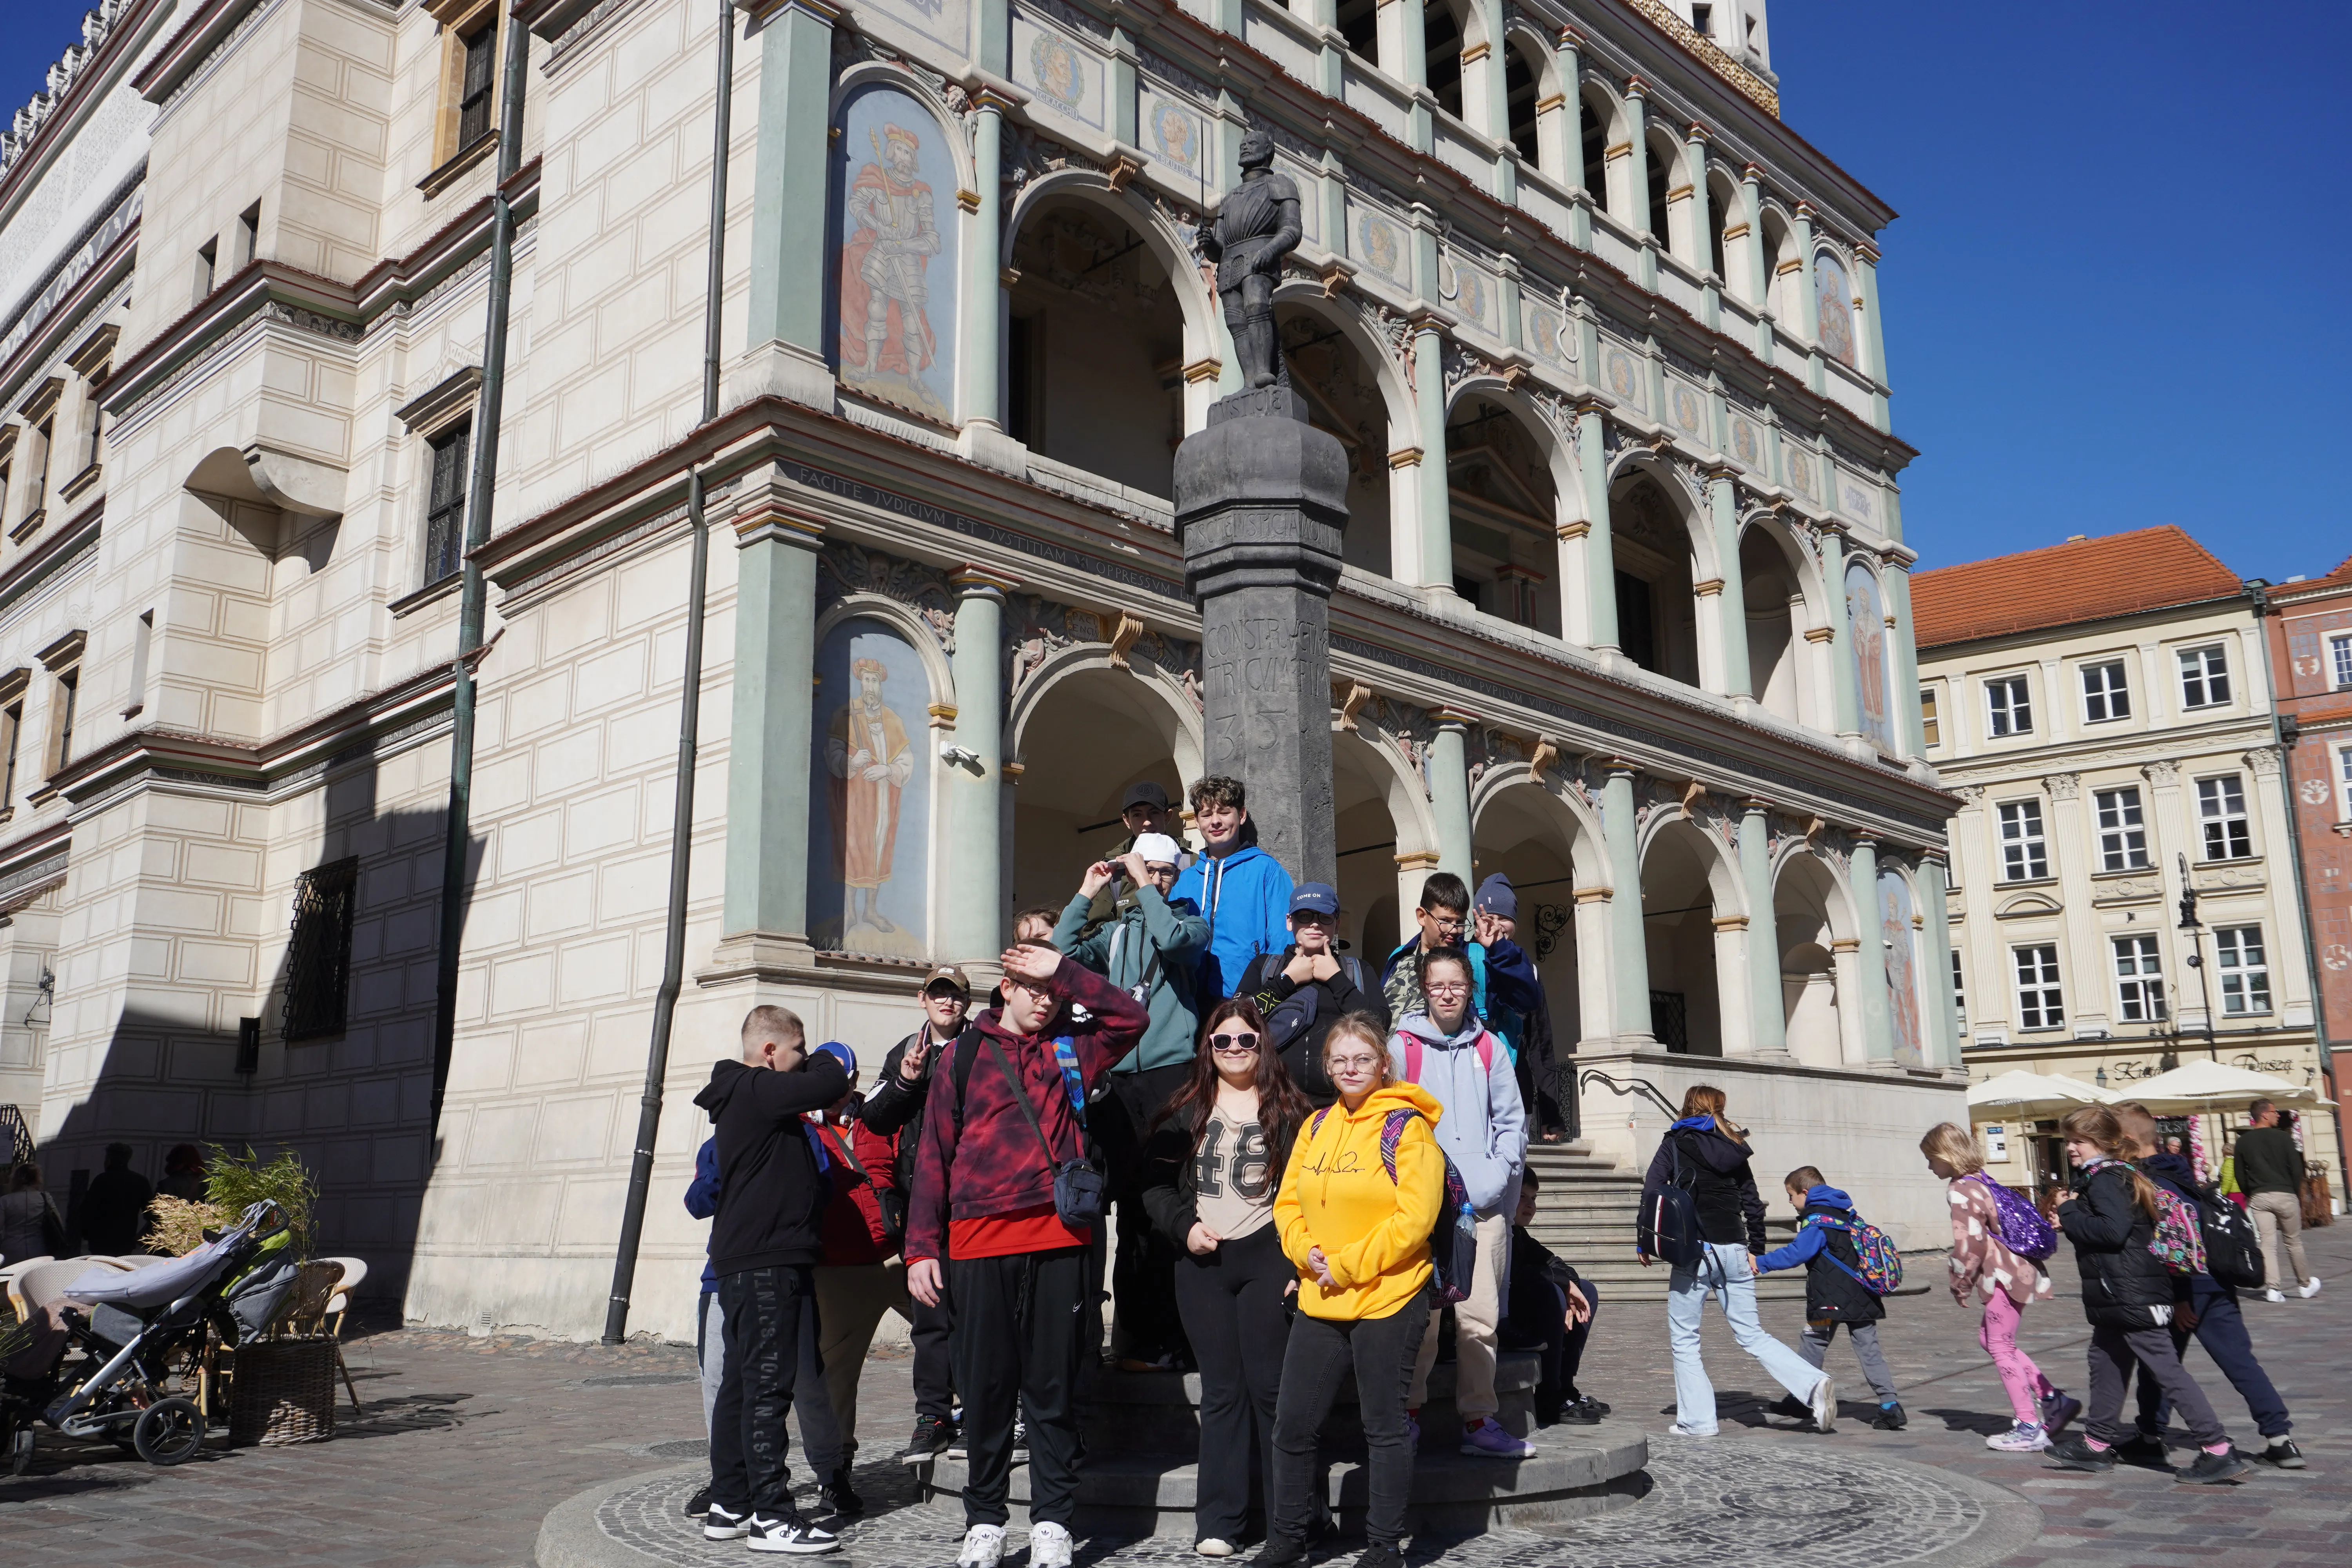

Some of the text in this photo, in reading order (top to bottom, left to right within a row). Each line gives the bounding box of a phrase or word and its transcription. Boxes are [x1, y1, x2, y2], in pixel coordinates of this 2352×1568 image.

[1040, 92, 1075, 118] GRACCHI
[1161, 156, 1189, 176] BRUTUS
[1365, 263, 1392, 284] VITRUVIUS
[1457, 311, 1482, 330] VERGILIUS
[1538, 353, 1560, 371] HOMERUS
[1849, 489, 1866, 511] 1999
[800, 468, 862, 499] FACITE
[873, 491, 946, 524] JVDICIVM
[957, 518, 978, 534] ET
[989, 527, 1066, 563] JVSTITIAM
[1096, 562, 1170, 595] OPPRESSVM
[1073, 612, 1096, 624] PACI
[1416, 664, 1472, 688] ADVENAM
[1479, 681, 1523, 704] PVPILVM
[1572, 711, 1606, 730] NOLITE
[1611, 723, 1666, 747] CONTRISTARE
[1693, 749, 1710, 760] NEC
[1715, 755, 1754, 774] POTENTIA
[1758, 768, 1795, 786] TVRPITER
[1799, 781, 1813, 792] NEC
